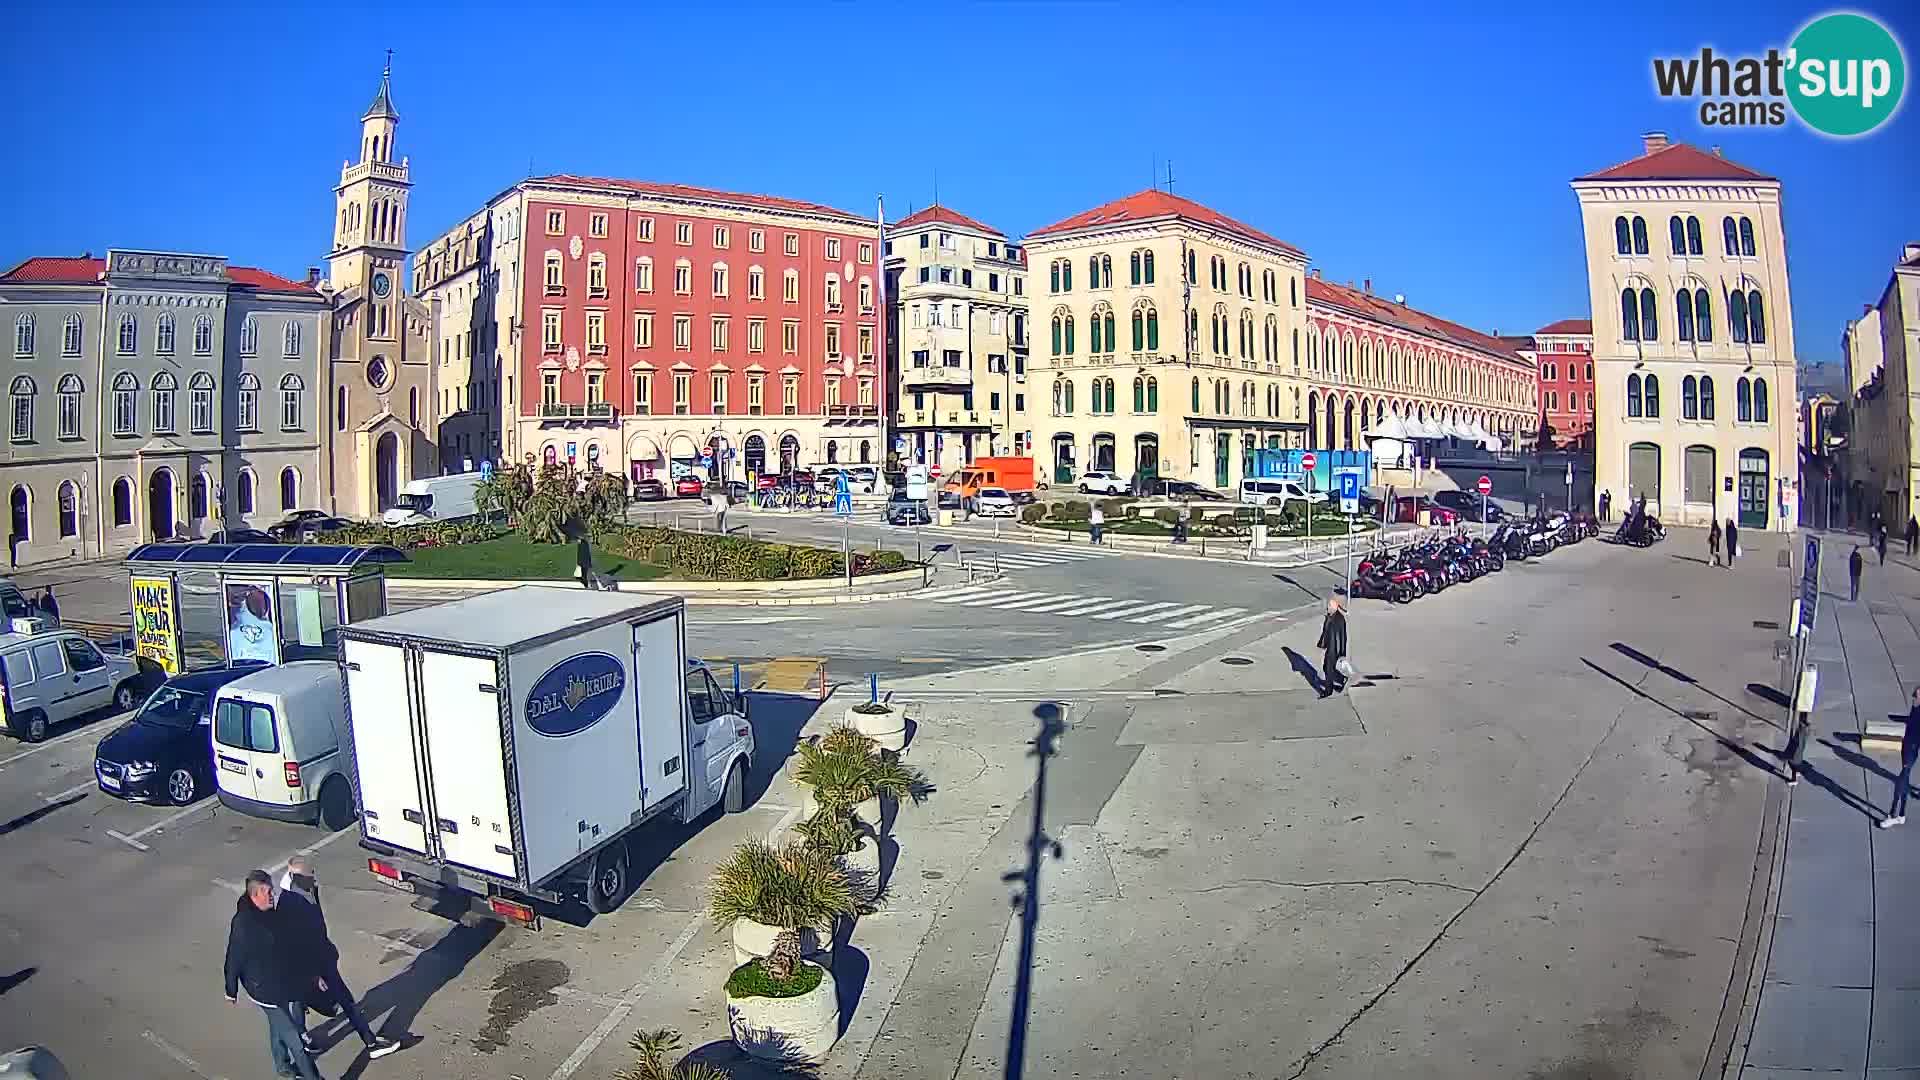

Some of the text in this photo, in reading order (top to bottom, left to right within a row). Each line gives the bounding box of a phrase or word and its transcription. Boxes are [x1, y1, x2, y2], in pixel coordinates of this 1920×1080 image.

[1344, 475, 1354, 495] P
[135, 585, 168, 608] MAKE
[136, 606, 171, 635] YOUR
